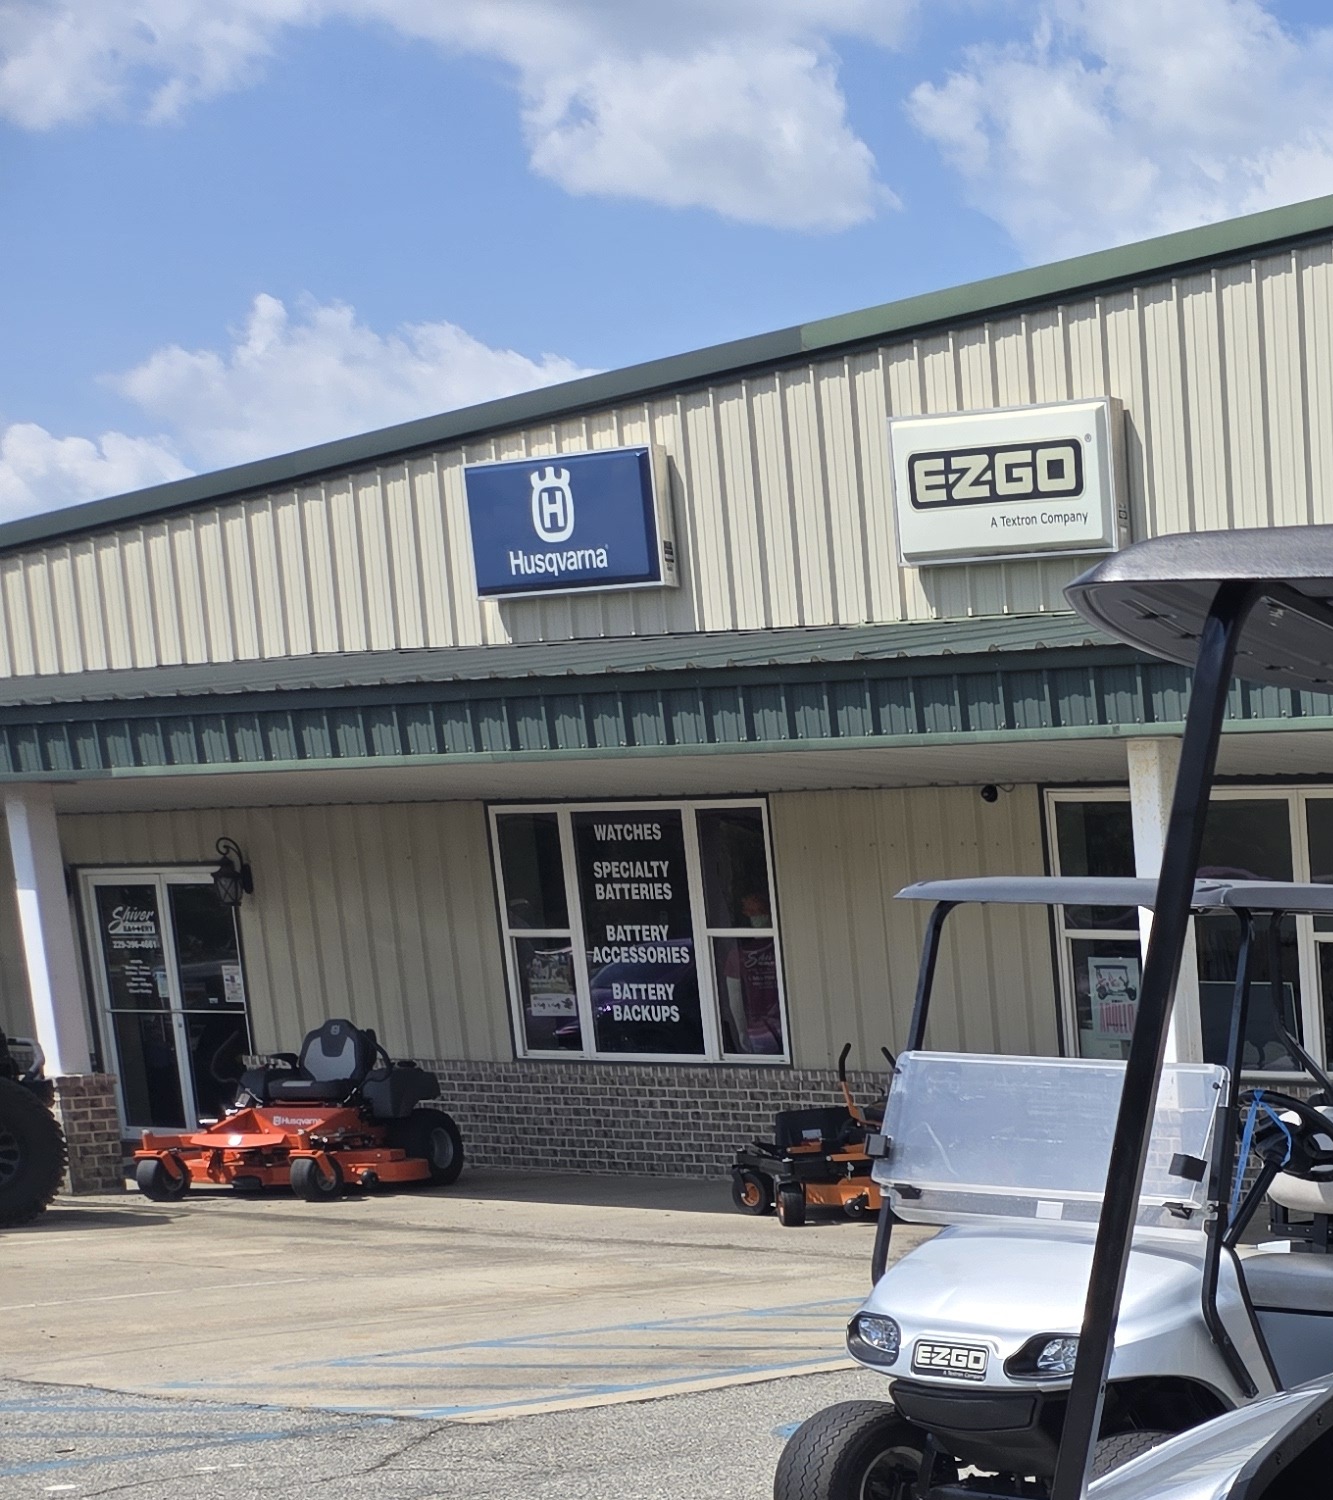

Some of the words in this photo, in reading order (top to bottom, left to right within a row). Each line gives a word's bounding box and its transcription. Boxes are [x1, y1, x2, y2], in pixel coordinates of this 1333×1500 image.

[913, 446, 1076, 503] EZGO
[990, 517, 998, 528] A
[1000, 515, 1038, 528] Textron
[1040, 511, 1089, 528] Company
[509, 547, 608, 576] Husqvarna
[594, 824, 662, 841] WATCHES
[593, 861, 669, 878] SPECIALTY
[595, 883, 673, 900] BATTERIES
[108, 906, 154, 934] Shiver
[606, 925, 669, 942] BATTERY
[592, 946, 690, 964] ACCESSORIES
[612, 983, 675, 1001] BATTERY
[613, 1005, 680, 1022] BACKUPS
[917, 1346, 986, 1369] EZGO
